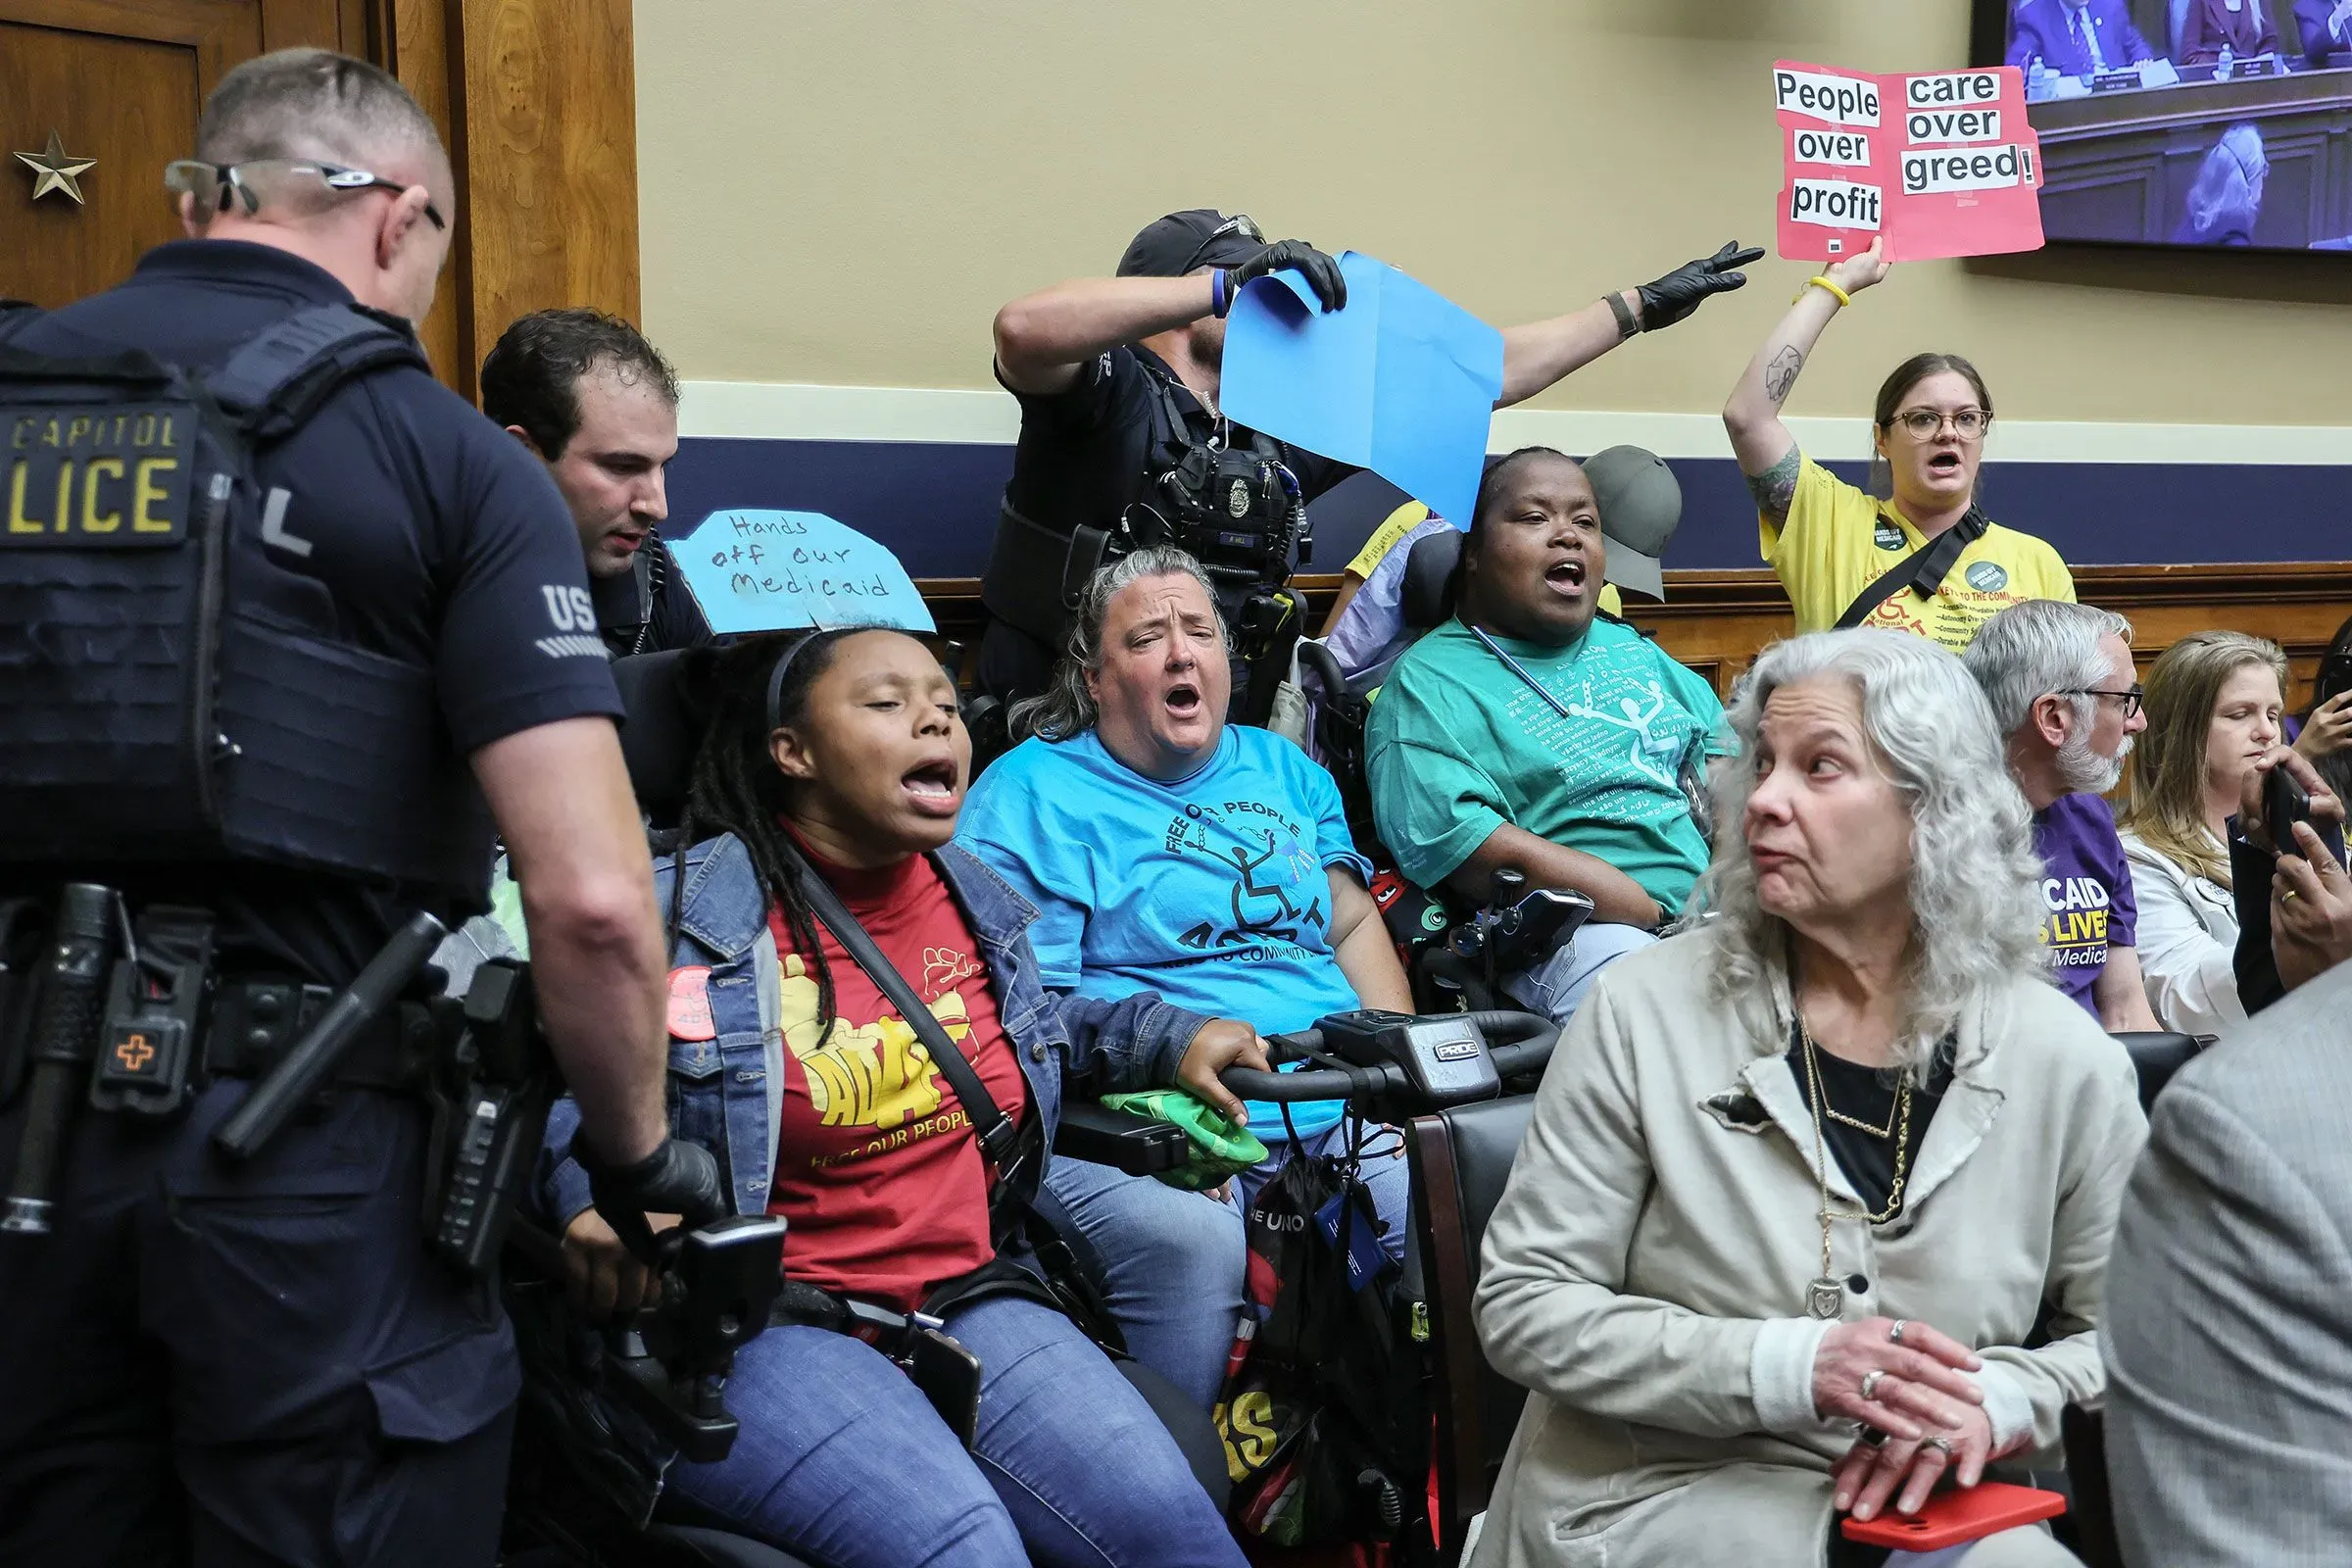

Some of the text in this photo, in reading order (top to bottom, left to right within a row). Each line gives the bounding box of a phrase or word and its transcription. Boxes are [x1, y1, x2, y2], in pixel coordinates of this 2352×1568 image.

[1776, 72, 1879, 121] People
[1910, 74, 1995, 103] care
[1909, 111, 1997, 139] over
[1797, 133, 1866, 161] over
[1791, 185, 1880, 224] profit
[12, 416, 176, 449] CAPITOL
[9, 458, 178, 532] LICE
[729, 516, 808, 538] Hands
[711, 544, 852, 567] off our
[1971, 592, 1986, 602] THE
[1223, 801, 1300, 838] PEOPLE
[2041, 878, 2110, 911] CAID
[2052, 945, 2108, 966] Medica
[1439, 1041, 1478, 1058] PRIDE
[868, 1129, 907, 1154] OUR
[912, 1109, 973, 1140] PEOPL
